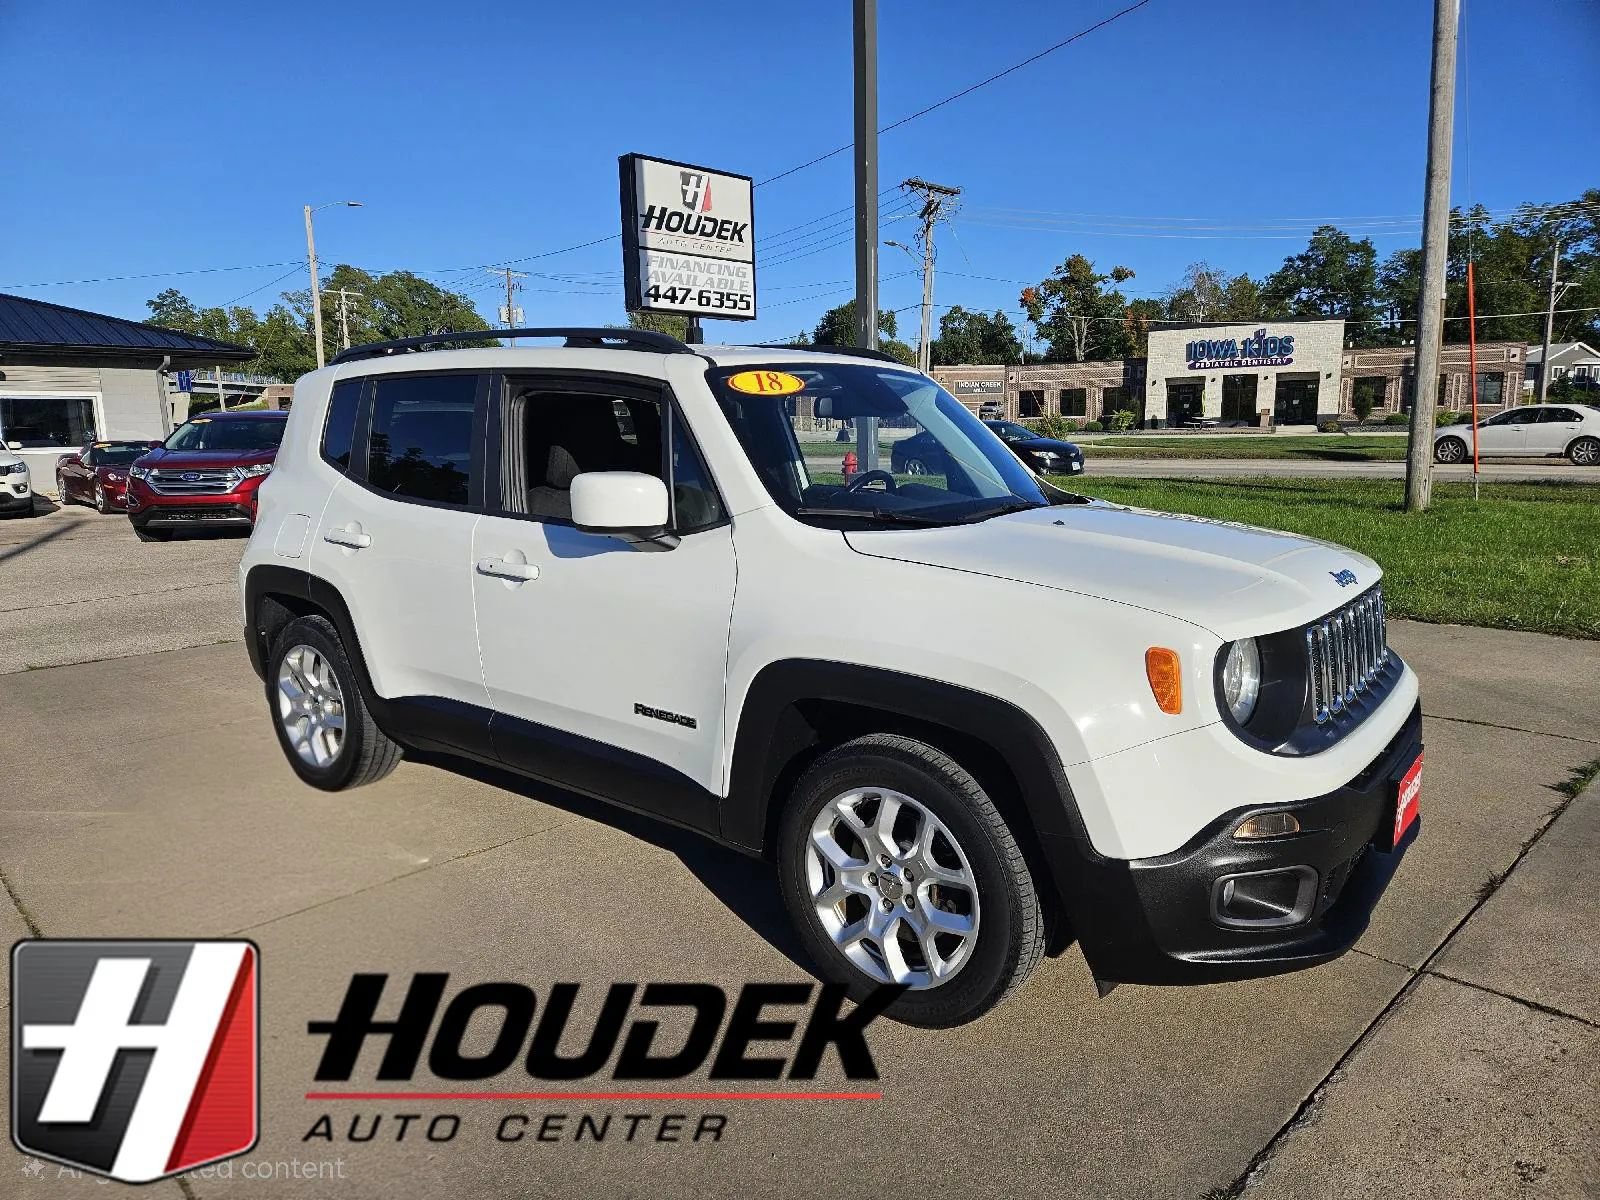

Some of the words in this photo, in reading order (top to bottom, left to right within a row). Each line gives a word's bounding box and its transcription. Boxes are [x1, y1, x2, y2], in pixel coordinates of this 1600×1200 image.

[640, 204, 748, 243] HOUDEK
[657, 237, 687, 248] AUTO
[647, 255, 747, 278] FINANCING
[646, 270, 750, 293] AVAILABLE
[644, 285, 751, 310] 447-6355
[1186, 339, 1239, 361] IOWA
[1195, 360, 1238, 369] PEDIATRIC
[1241, 358, 1288, 366] DENTISTRY
[752, 372, 783, 392] 18
